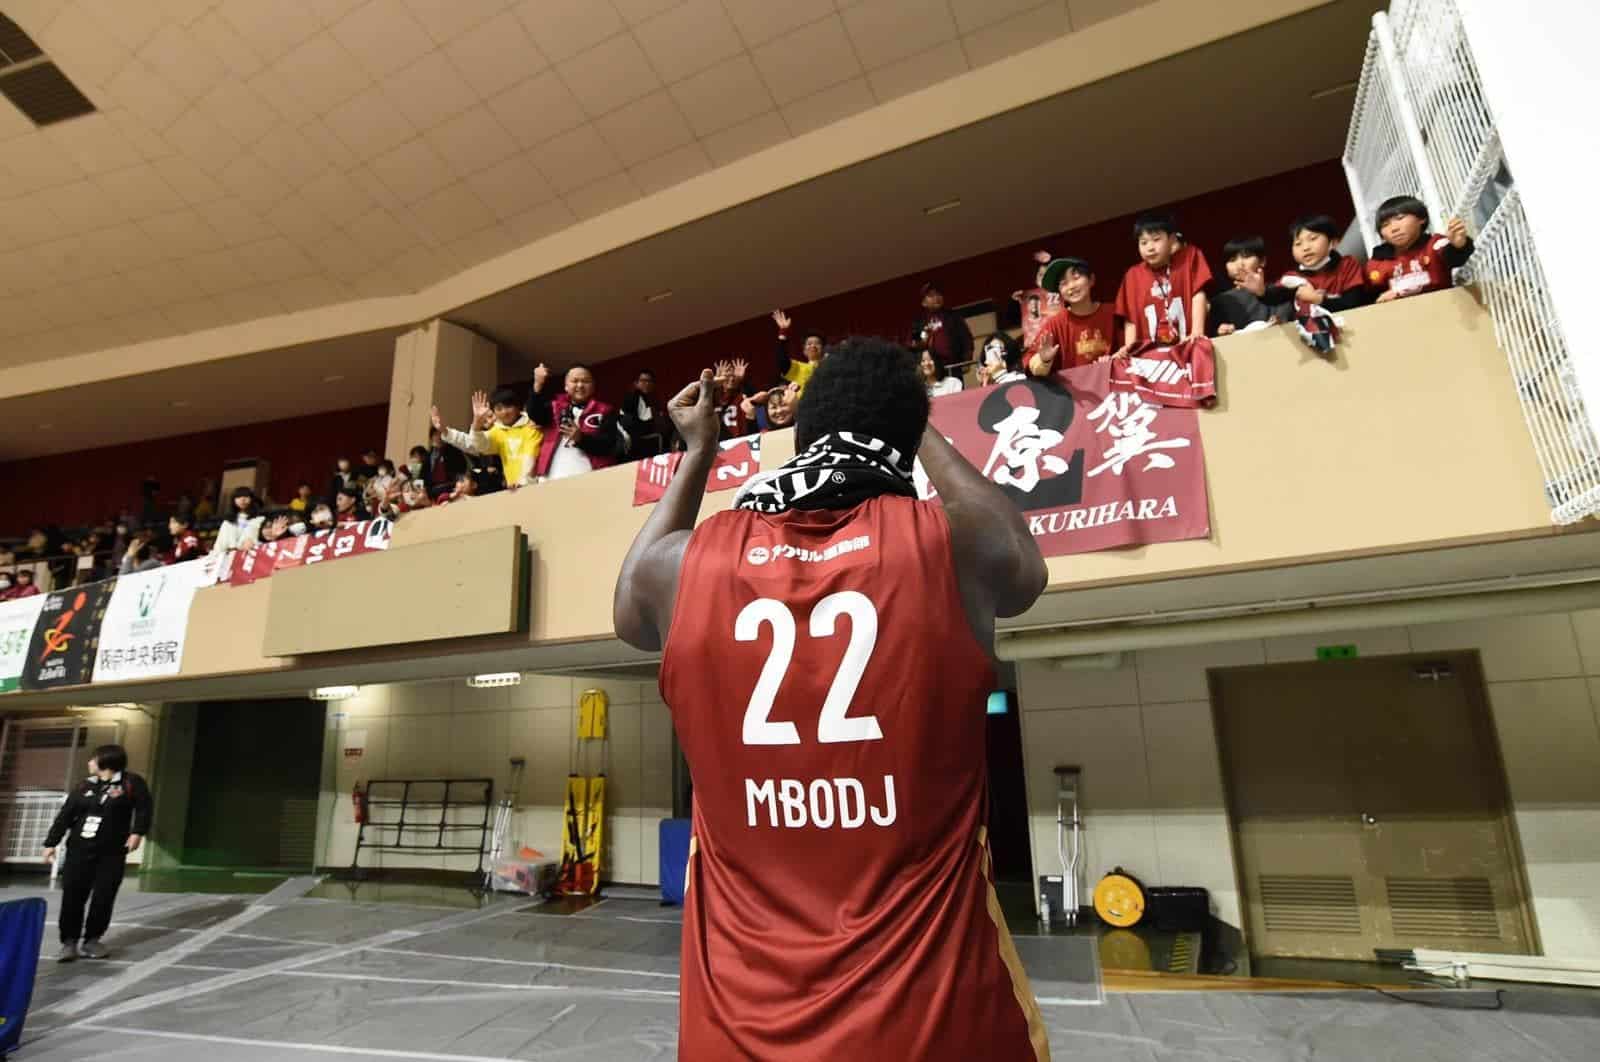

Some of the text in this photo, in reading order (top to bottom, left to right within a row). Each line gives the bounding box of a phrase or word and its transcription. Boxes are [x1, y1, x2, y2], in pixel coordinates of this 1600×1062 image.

[1029, 495, 1178, 536] KURIHARA
[734, 590, 883, 745] 22
[745, 775, 897, 829] MBODJ
